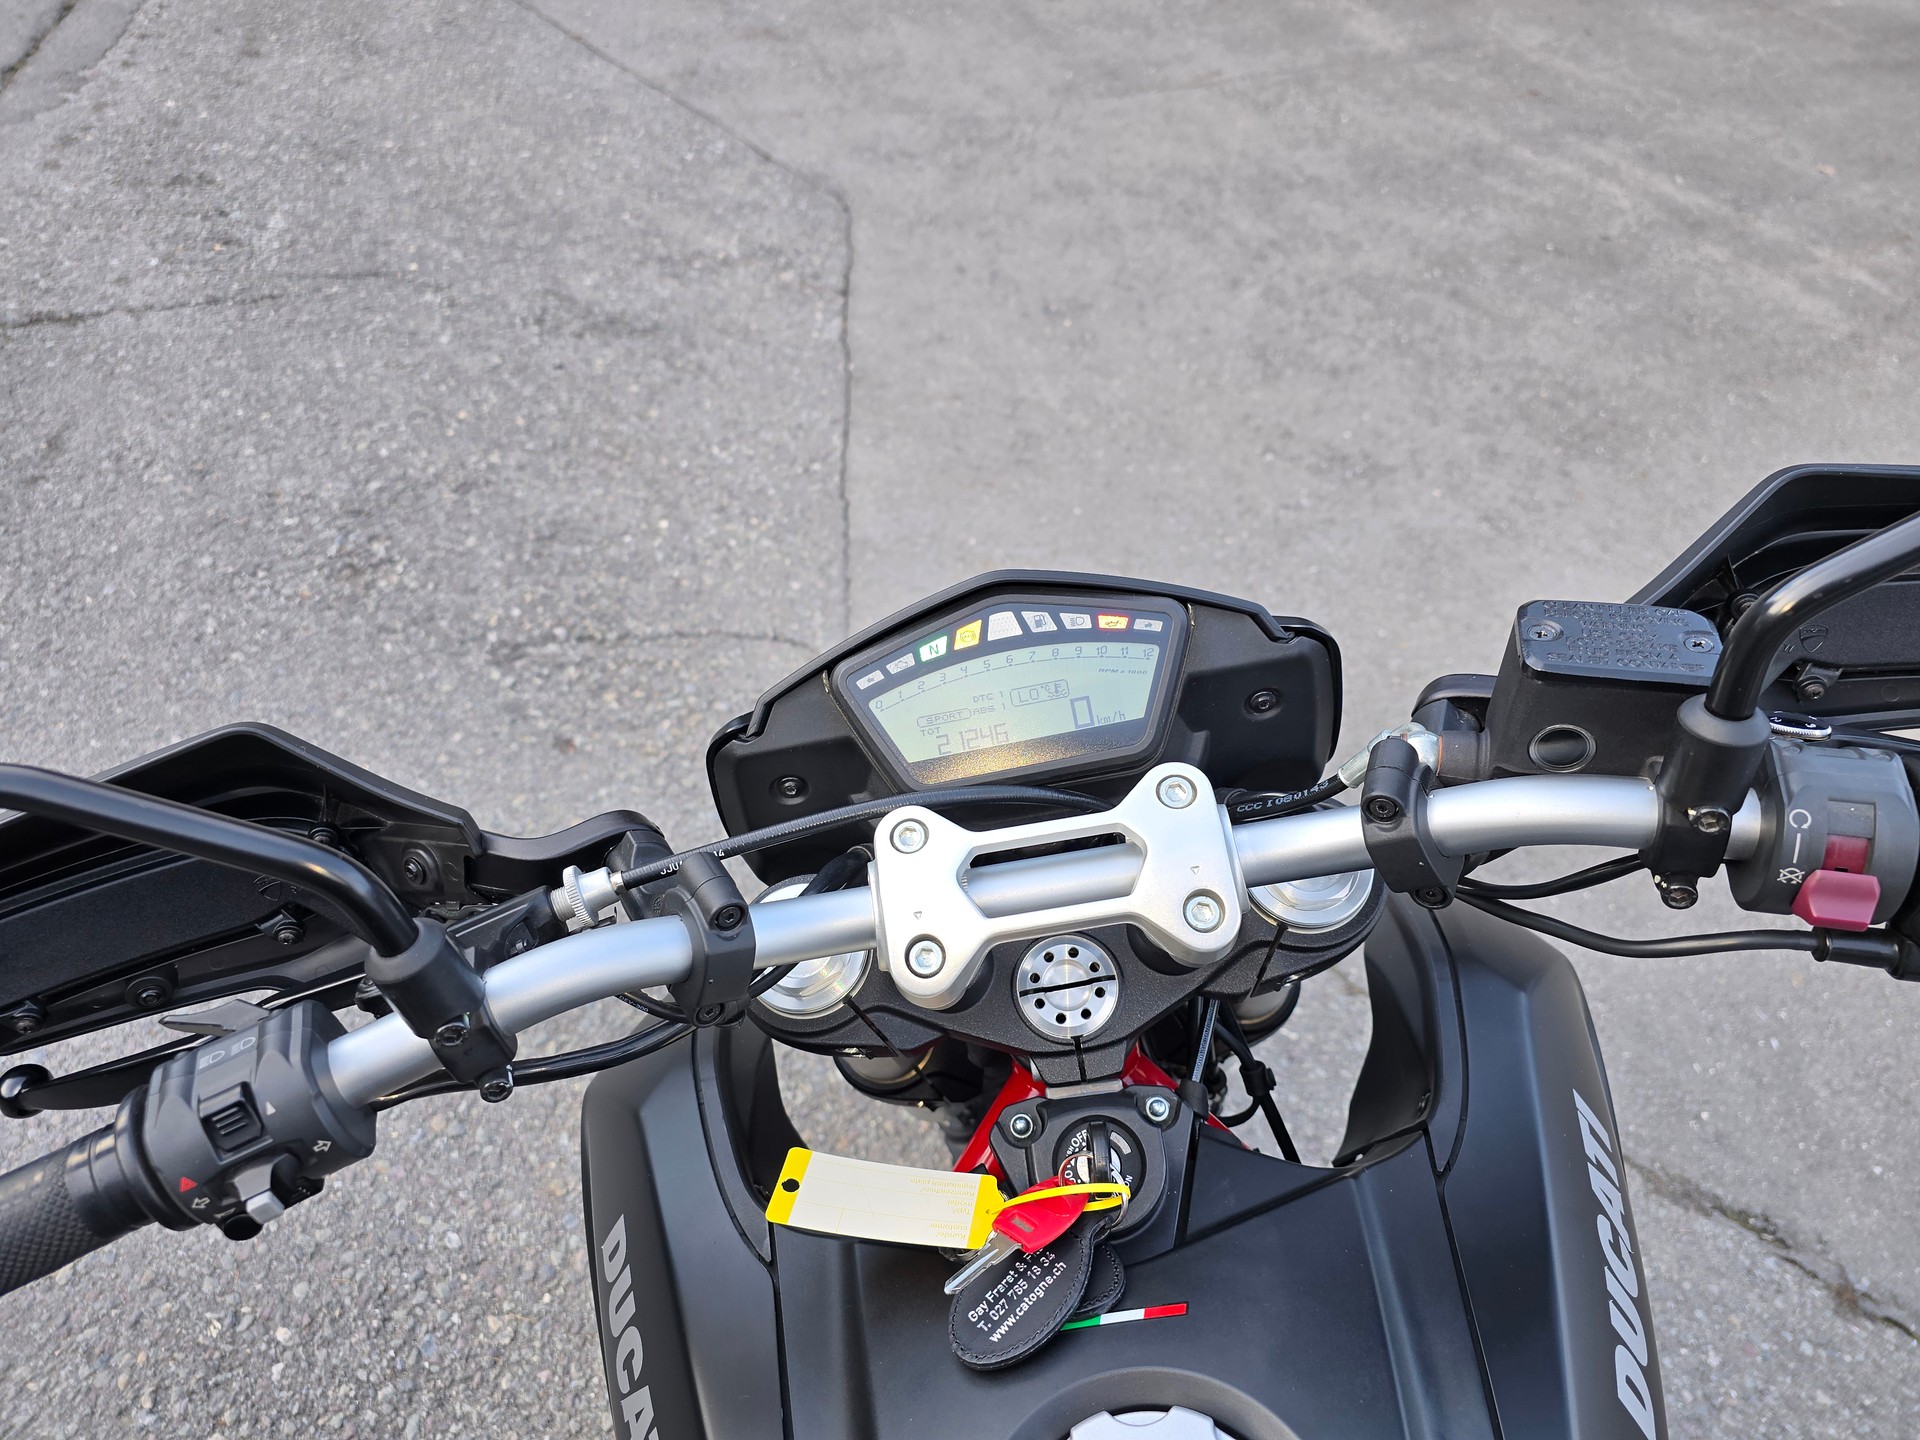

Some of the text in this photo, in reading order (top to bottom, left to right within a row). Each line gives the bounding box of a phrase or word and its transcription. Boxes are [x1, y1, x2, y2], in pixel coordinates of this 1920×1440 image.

[1609, 613, 1690, 626] REMOVING
[928, 644, 940, 656] N
[1617, 658, 1704, 673] CONTAINER
[875, 700, 883, 710] 0
[918, 681, 925, 691] 2
[940, 673, 946, 681] 3
[961, 666, 968, 674] 4
[984, 660, 991, 669] 5
[1006, 655, 1013, 664] 6
[1029, 651, 1036, 661] 7
[1052, 648, 1059, 657] 8
[1075, 646, 1083, 655] 9
[1097, 645, 1108, 656] 10
[1121, 646, 1129, 655] 11
[1142, 648, 1155, 657] 12
[973, 693, 994, 703] DTC
[973, 704, 996, 716] ABS
[1070, 695, 1126, 729] 0 km/h
[926, 711, 964, 725] SPORT
[920, 726, 941, 737] TOT
[1236, 802, 1262, 812] CCC
[1573, 1088, 1657, 1440] DUCATI
[989, 1261, 1067, 1342] www.catogne.ch
[968, 1300, 989, 1322] Gay
[977, 1320, 992, 1332] T.
[989, 1298, 1009, 1320] 027
[602, 1213, 660, 1440] DUCA
